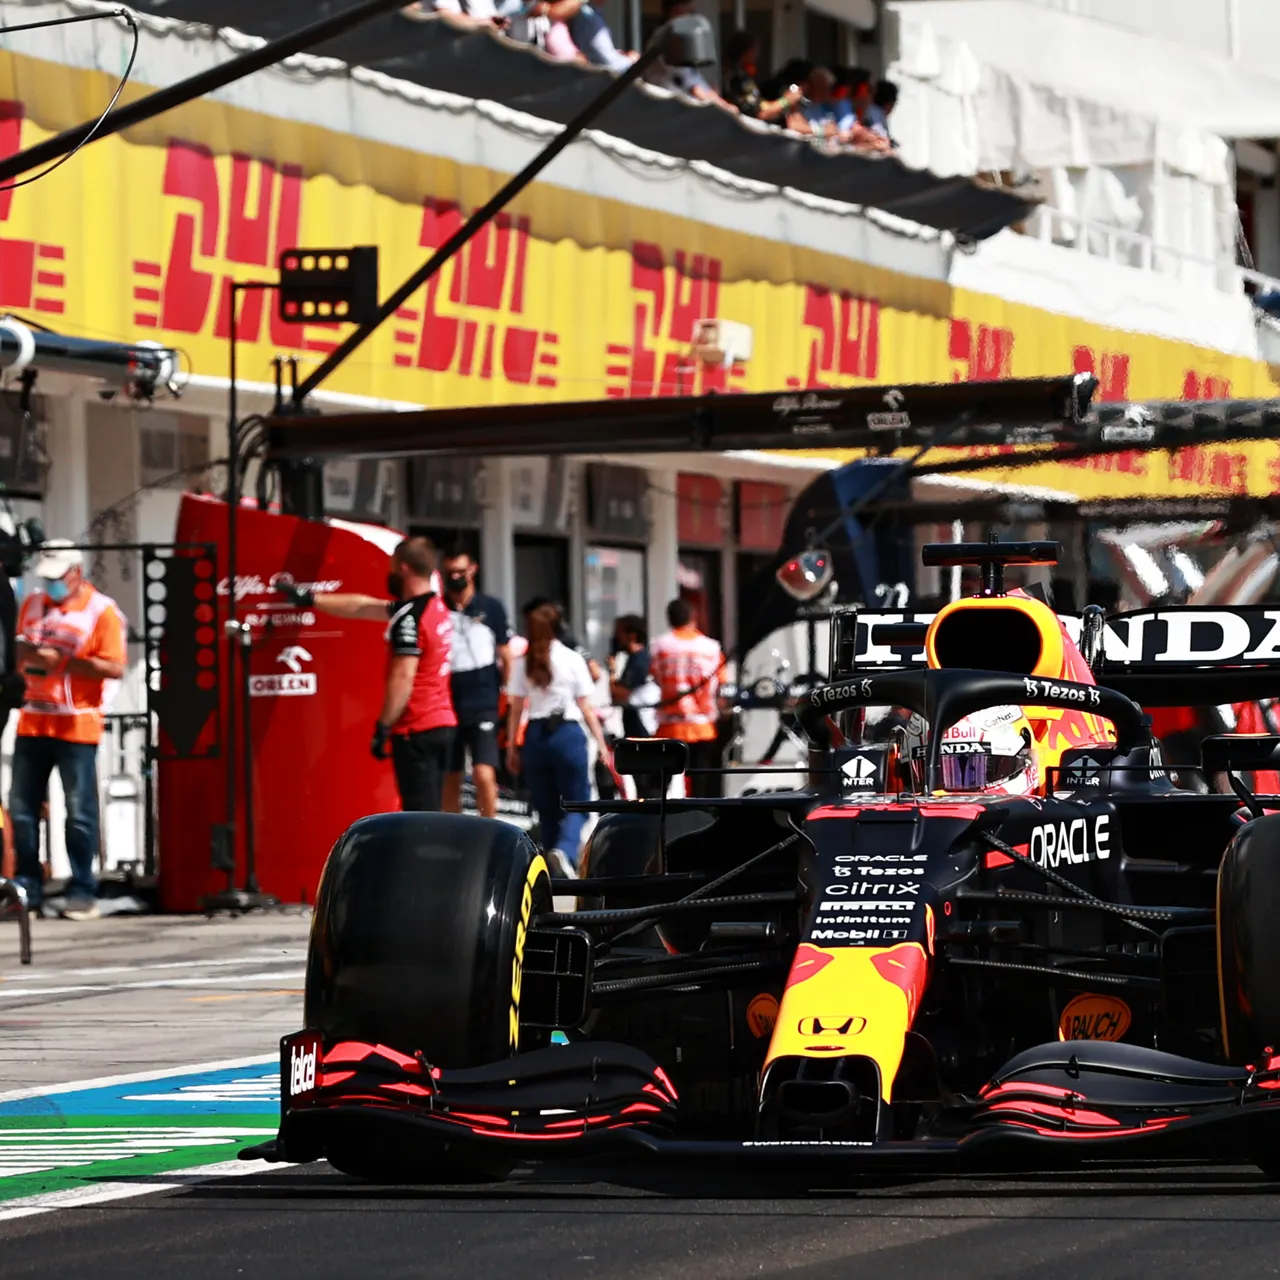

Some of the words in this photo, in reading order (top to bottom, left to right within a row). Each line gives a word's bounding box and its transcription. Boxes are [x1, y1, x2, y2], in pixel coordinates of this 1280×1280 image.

[253, 677, 310, 692] ORLEN
[1042, 680, 1087, 703] Tezos
[821, 683, 857, 703] Tezos
[952, 727, 976, 738] Bull
[842, 777, 875, 786] NTER
[1066, 777, 1100, 787] INTER
[1030, 814, 1111, 869] ORACLE
[834, 854, 929, 862] ORACLE
[858, 866, 925, 876] Tezos
[825, 881, 921, 895] citrix
[811, 929, 879, 939] Mobil
[1071, 1011, 1123, 1041] RAUCH
[290, 1042, 317, 1096] telcel
